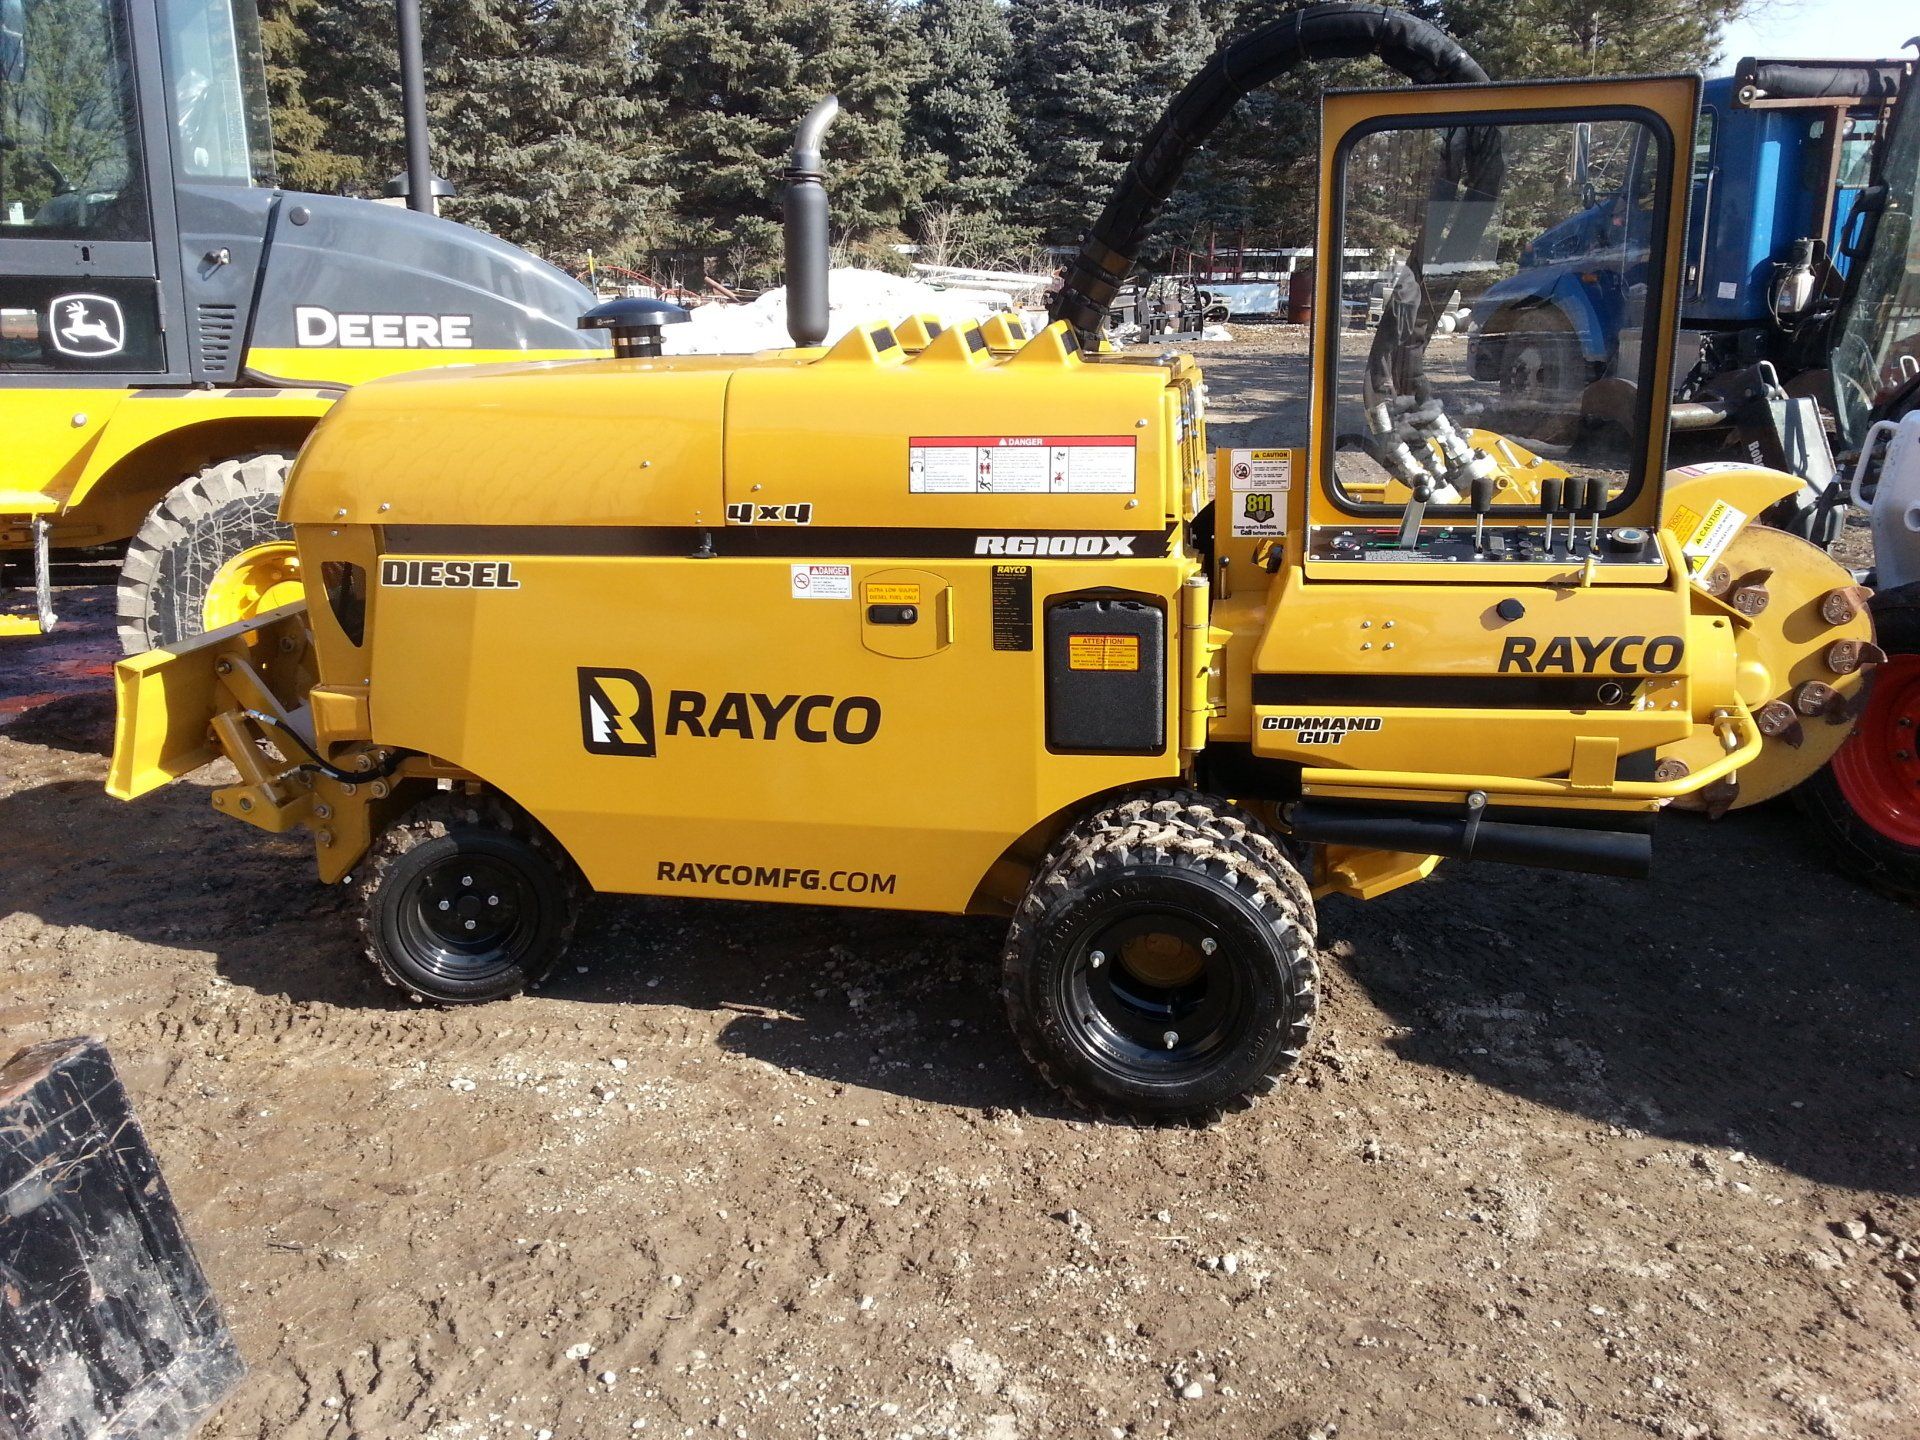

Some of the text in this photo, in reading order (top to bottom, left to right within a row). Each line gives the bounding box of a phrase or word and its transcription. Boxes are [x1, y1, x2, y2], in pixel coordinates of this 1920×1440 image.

[295, 306, 472, 348] DEERE
[1008, 437, 1043, 446] DANGER
[726, 503, 812, 525] 4x4
[1246, 494, 1272, 512] 811
[1698, 503, 1725, 537] CAUTION
[975, 536, 1137, 555] RG100X
[382, 560, 520, 589] DIESEL
[818, 567, 847, 575] DANGER
[1498, 635, 1685, 674] RAYCO
[665, 690, 881, 744] RAYCO
[1262, 717, 1382, 731] COMMAND
[1297, 731, 1347, 744] CUT
[656, 861, 897, 894] RAYCOMFG.COM
